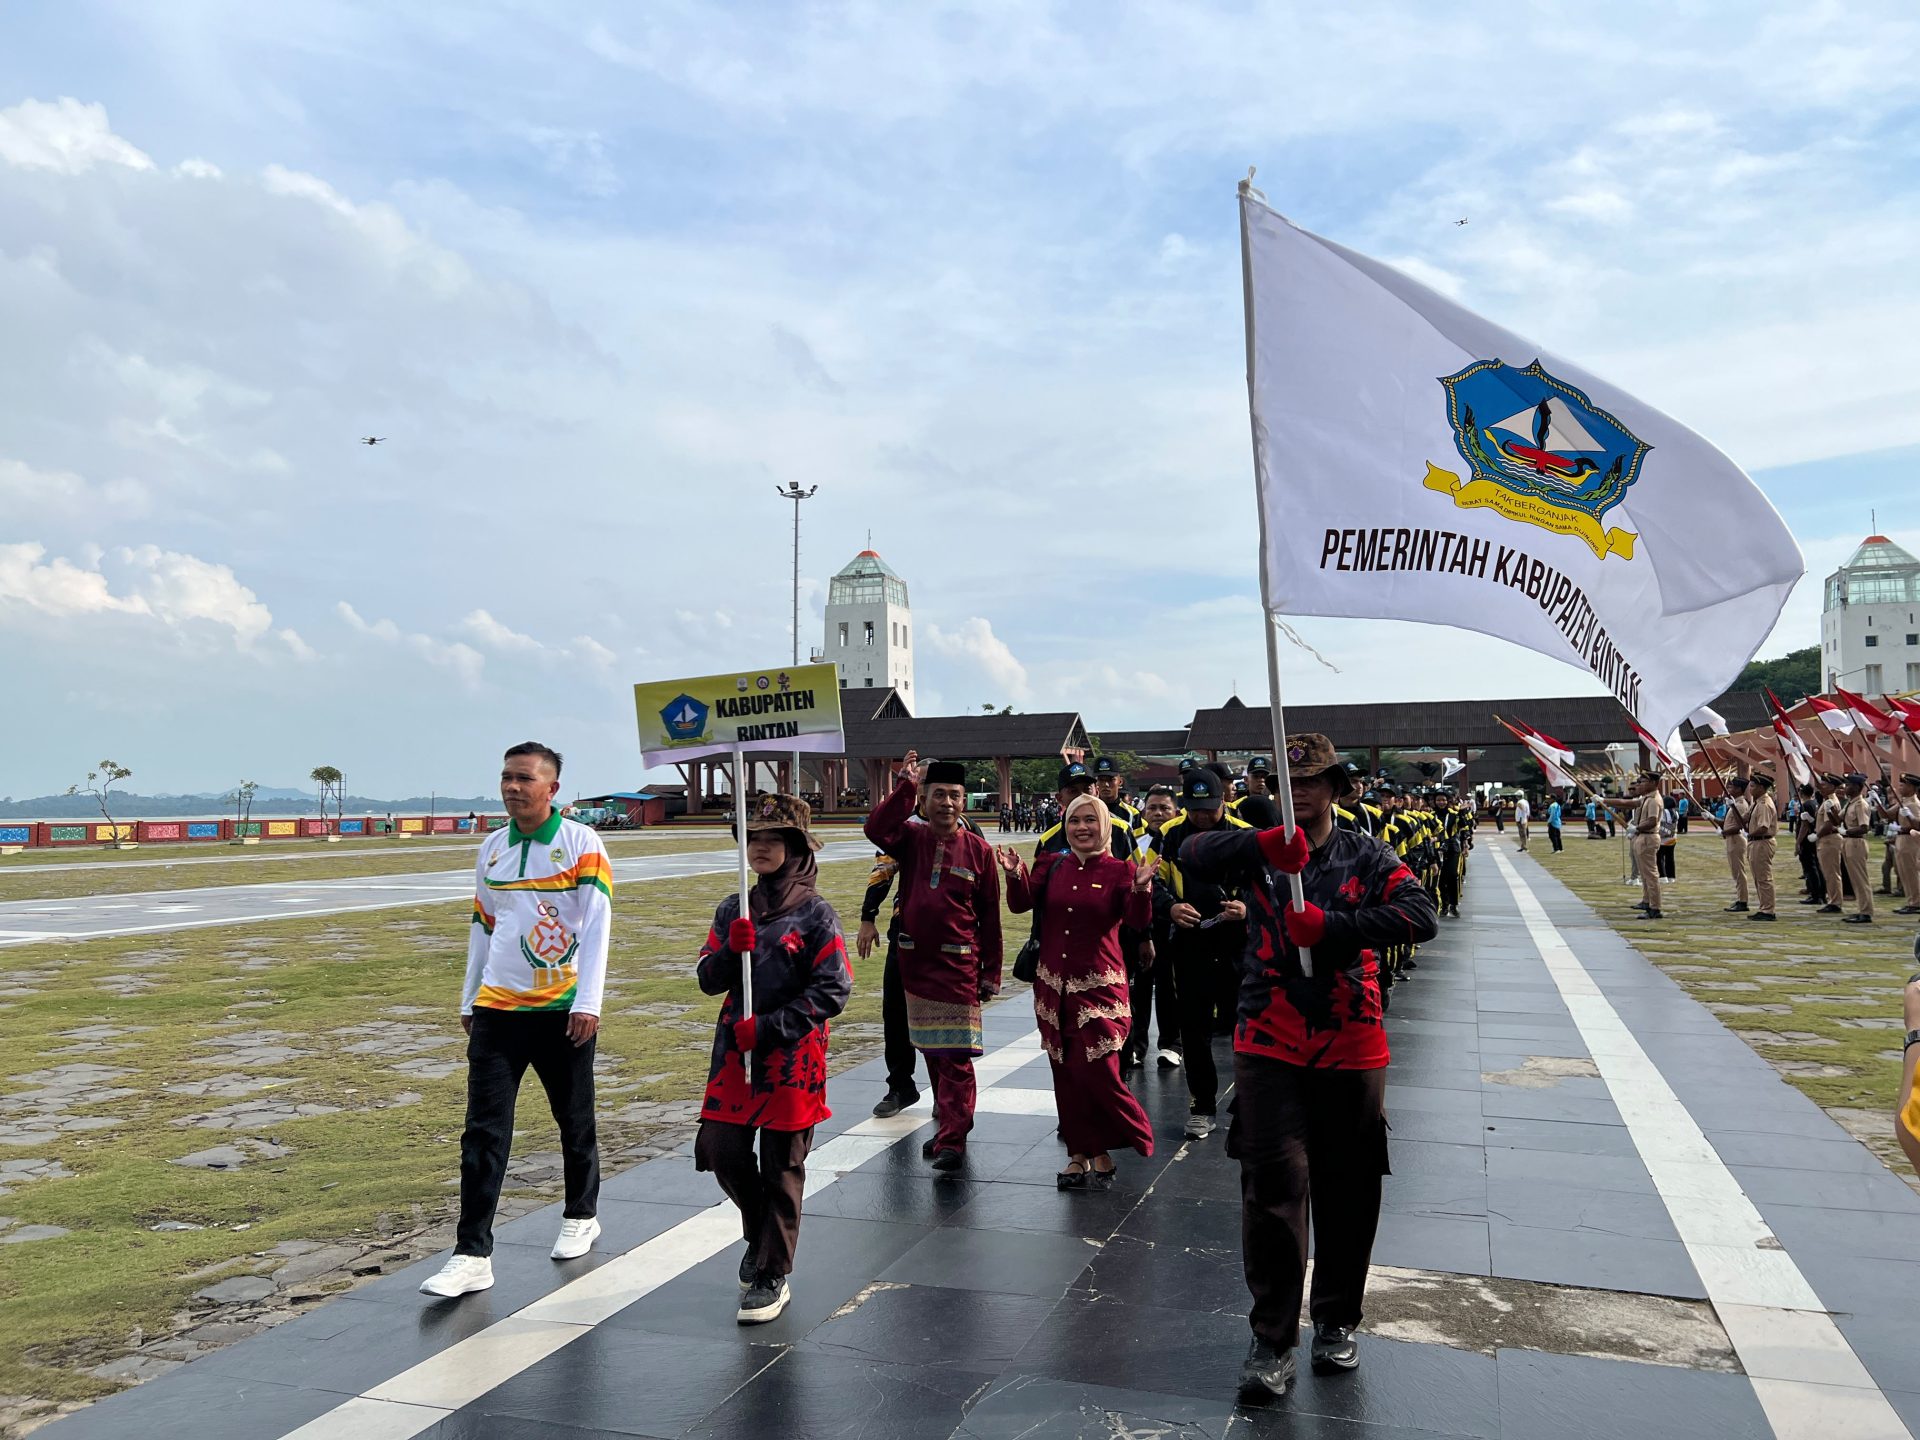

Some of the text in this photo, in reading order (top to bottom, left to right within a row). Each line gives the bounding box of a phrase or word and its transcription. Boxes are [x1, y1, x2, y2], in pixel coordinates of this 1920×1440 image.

[1320, 528, 1642, 718] PEMERINTAH KABUPATEN BINTAN
[716, 690, 815, 718] KABUPATEN
[737, 721, 798, 742] BINTAN
